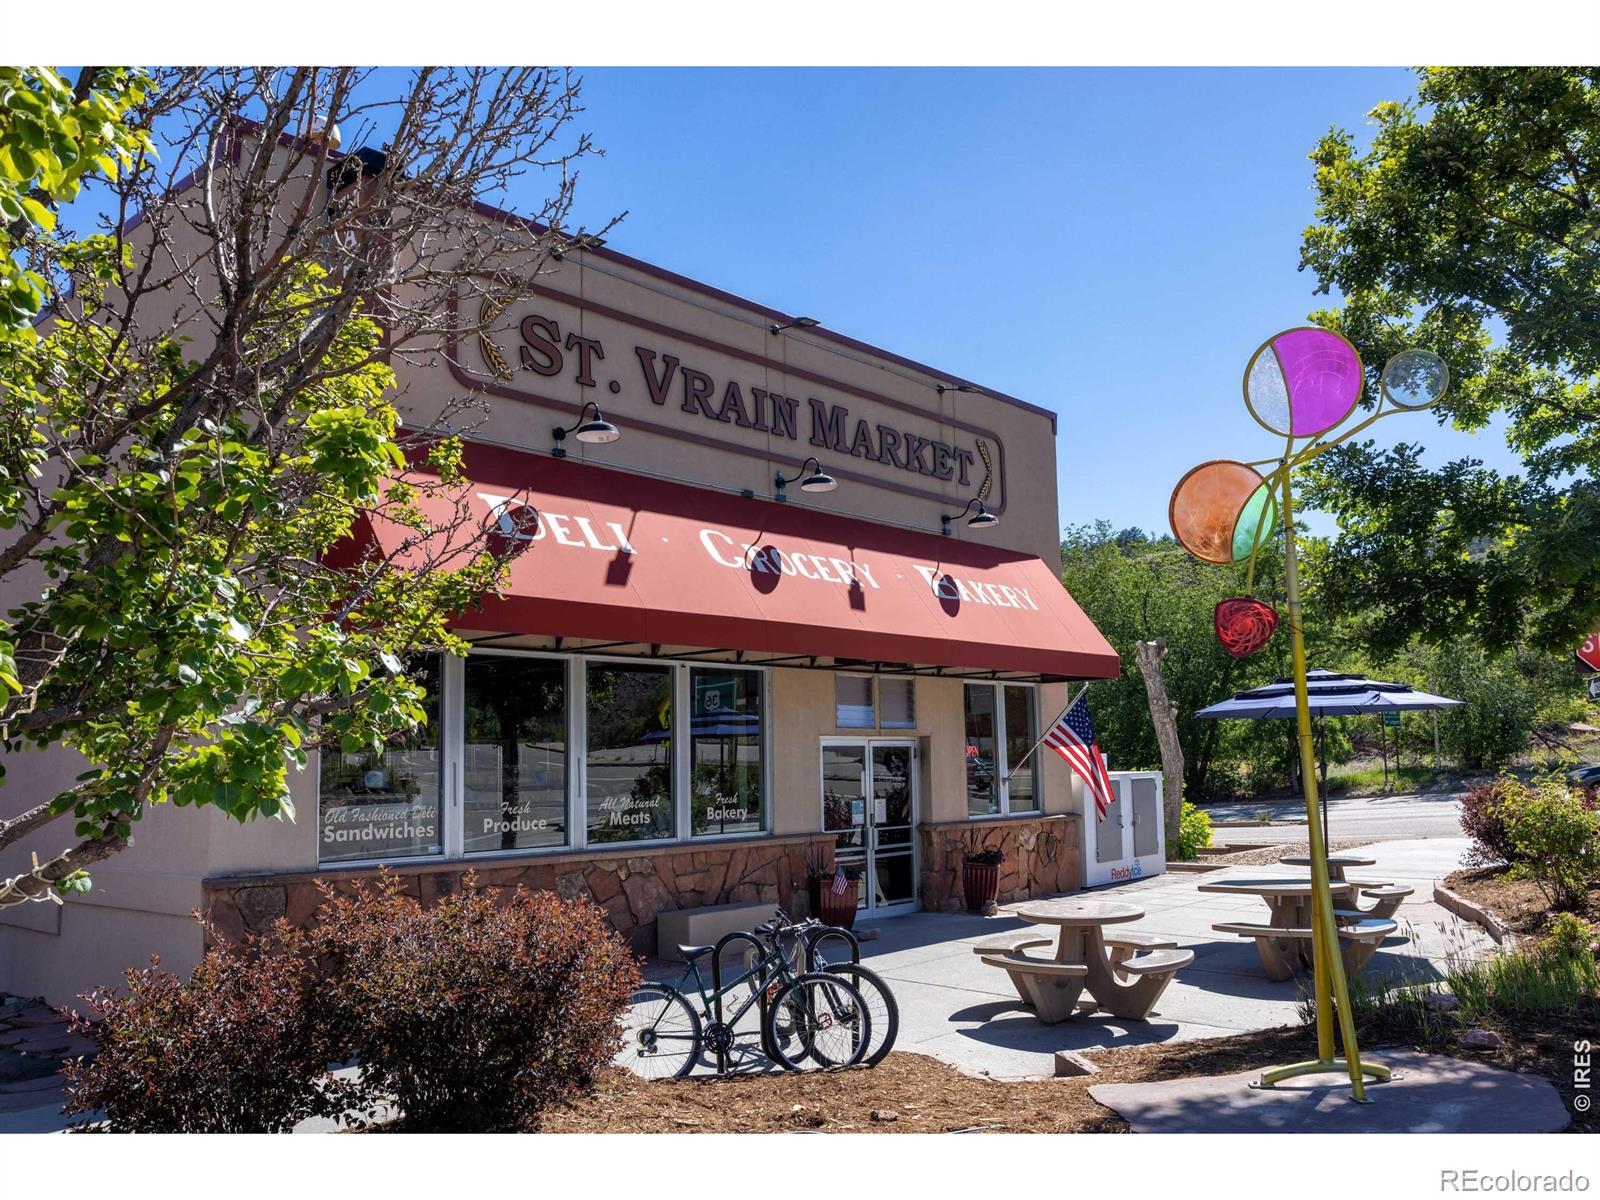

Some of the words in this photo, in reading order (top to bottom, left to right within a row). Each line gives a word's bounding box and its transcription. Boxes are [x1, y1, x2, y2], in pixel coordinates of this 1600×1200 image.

[519, 314, 622, 394] ST.
[635, 346, 800, 441] VRAIN
[808, 398, 975, 487] MARKET
[476, 491, 638, 555] DELI
[698, 528, 881, 589] GROCERY
[912, 564, 1040, 611] BAKERY
[500, 799, 531, 815] Fresh
[599, 796, 618, 811] All
[620, 795, 661, 810] Natural
[715, 792, 738, 805] Fresh
[324, 808, 348, 824] Old
[351, 806, 409, 823] Fashioned
[412, 804, 436, 820] Deli
[609, 811, 651, 826] Meats
[706, 805, 748, 821] Bakery
[323, 821, 435, 843] Sandwiches
[483, 815, 548, 833] Produce
